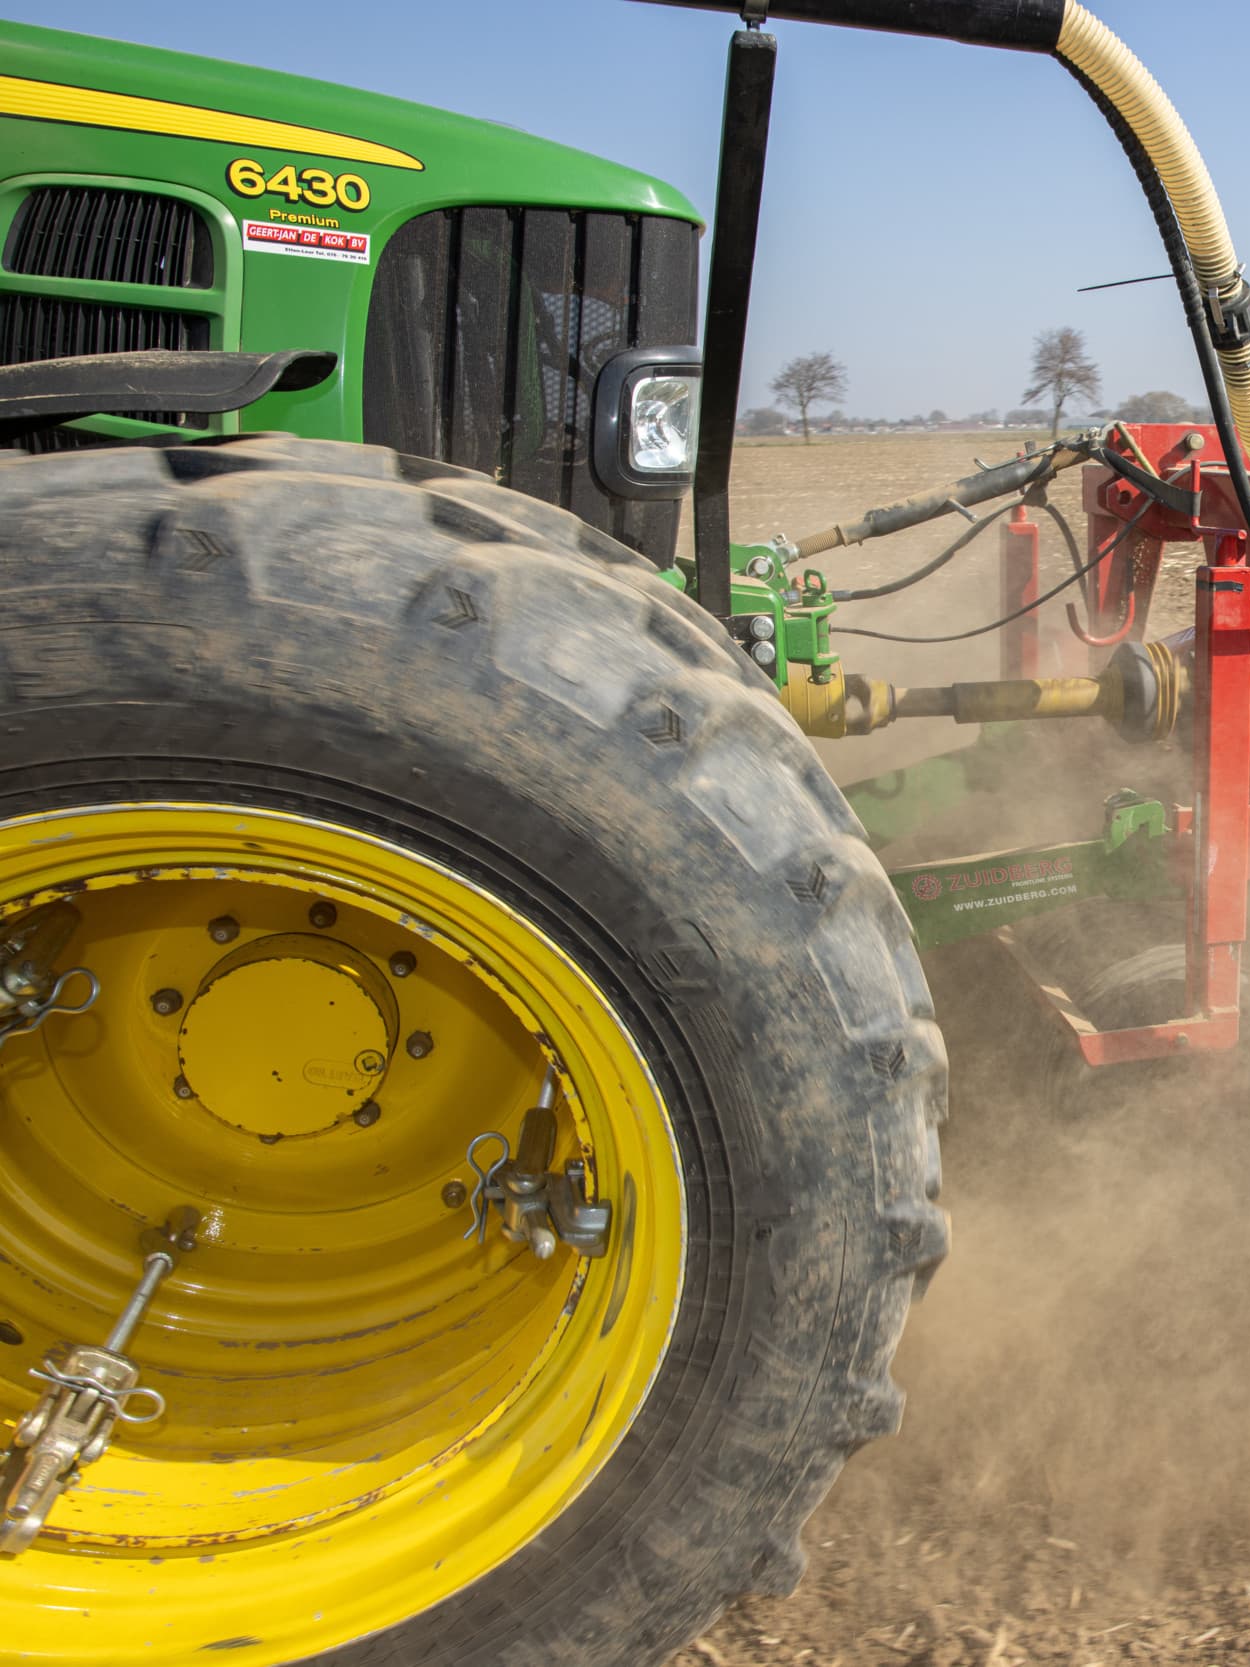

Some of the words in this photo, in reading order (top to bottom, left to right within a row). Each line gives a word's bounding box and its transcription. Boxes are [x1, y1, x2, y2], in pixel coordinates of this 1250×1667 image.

[225, 158, 371, 212] 6430
[269, 208, 339, 228] Premium
[249, 226, 297, 240] GEERT-JAN
[303, 232, 317, 243] DE
[324, 235, 345, 247] KOK
[351, 239, 365, 249] BV
[945, 856, 1073, 892] ZUIDBERG
[953, 884, 1078, 912] WWW.ZUIDBERG.COM
